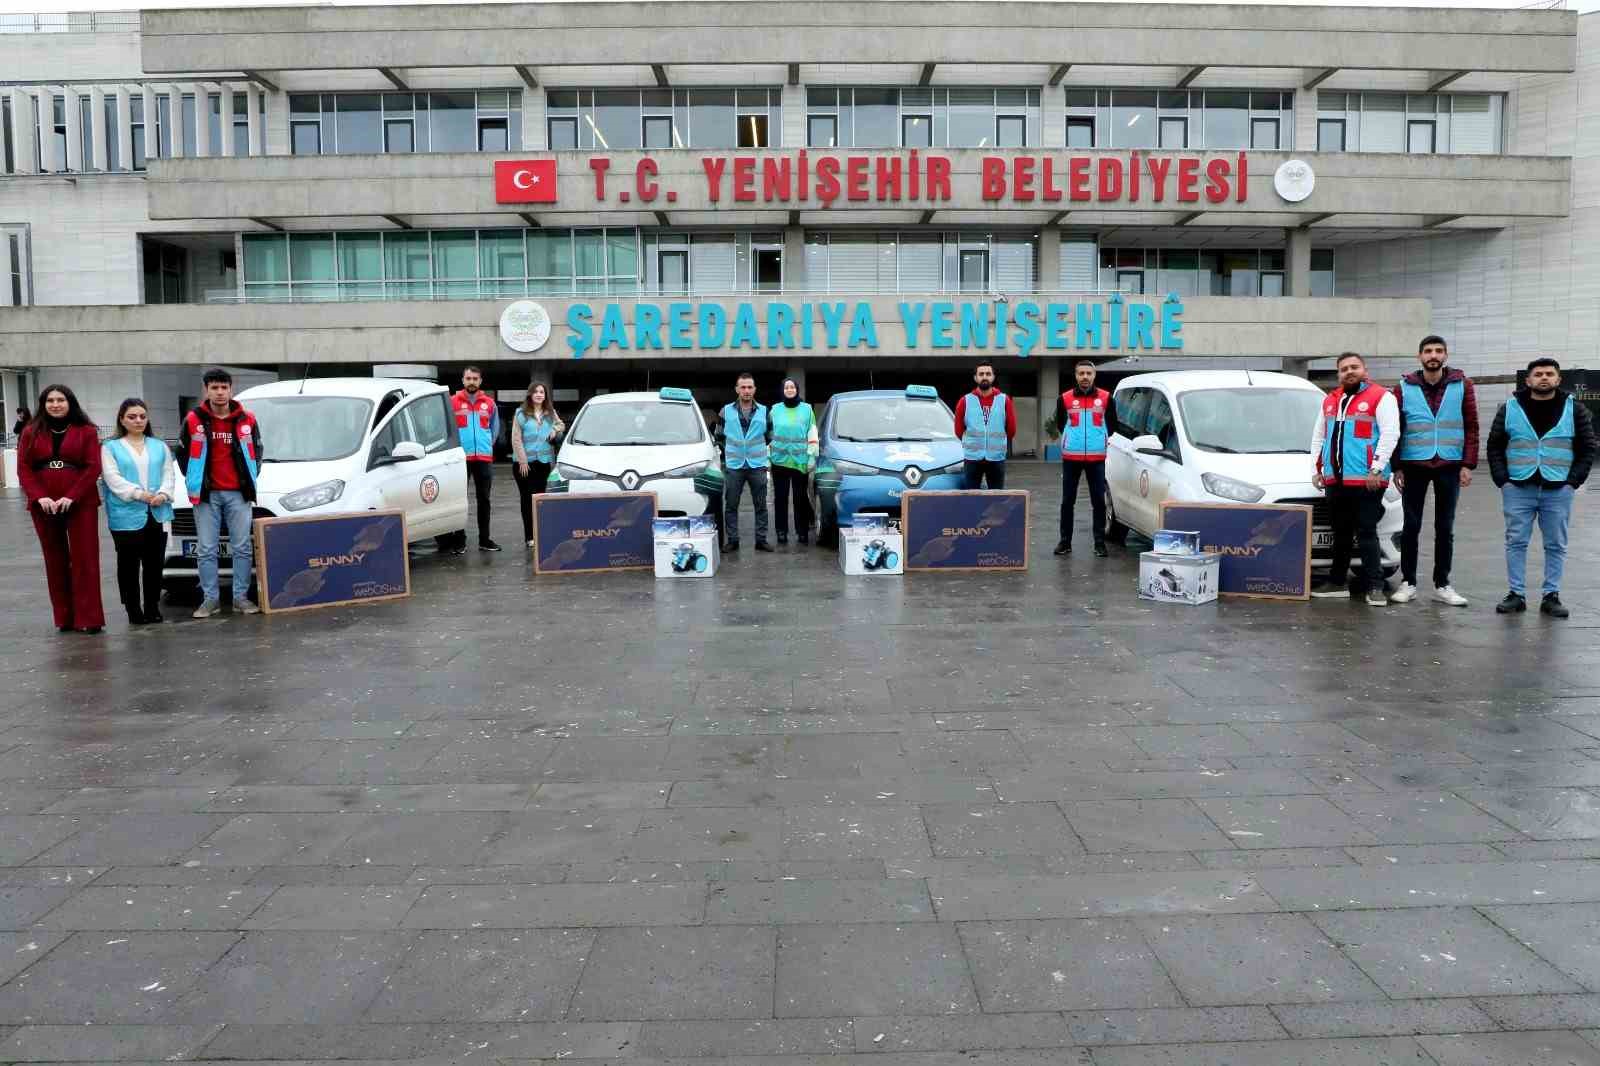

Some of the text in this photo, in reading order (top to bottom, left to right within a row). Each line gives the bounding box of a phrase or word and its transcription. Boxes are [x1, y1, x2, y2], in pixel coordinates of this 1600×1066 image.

[589, 149, 1248, 207] T.C. YENİŞEHİR BELEDİYESİ
[567, 302, 880, 362] ŞAREDARIYA
[572, 528, 620, 538] SUNNY
[941, 527, 991, 537] SUNNY
[1202, 544, 1264, 557] SUNNY
[308, 552, 366, 568] SUNNY
